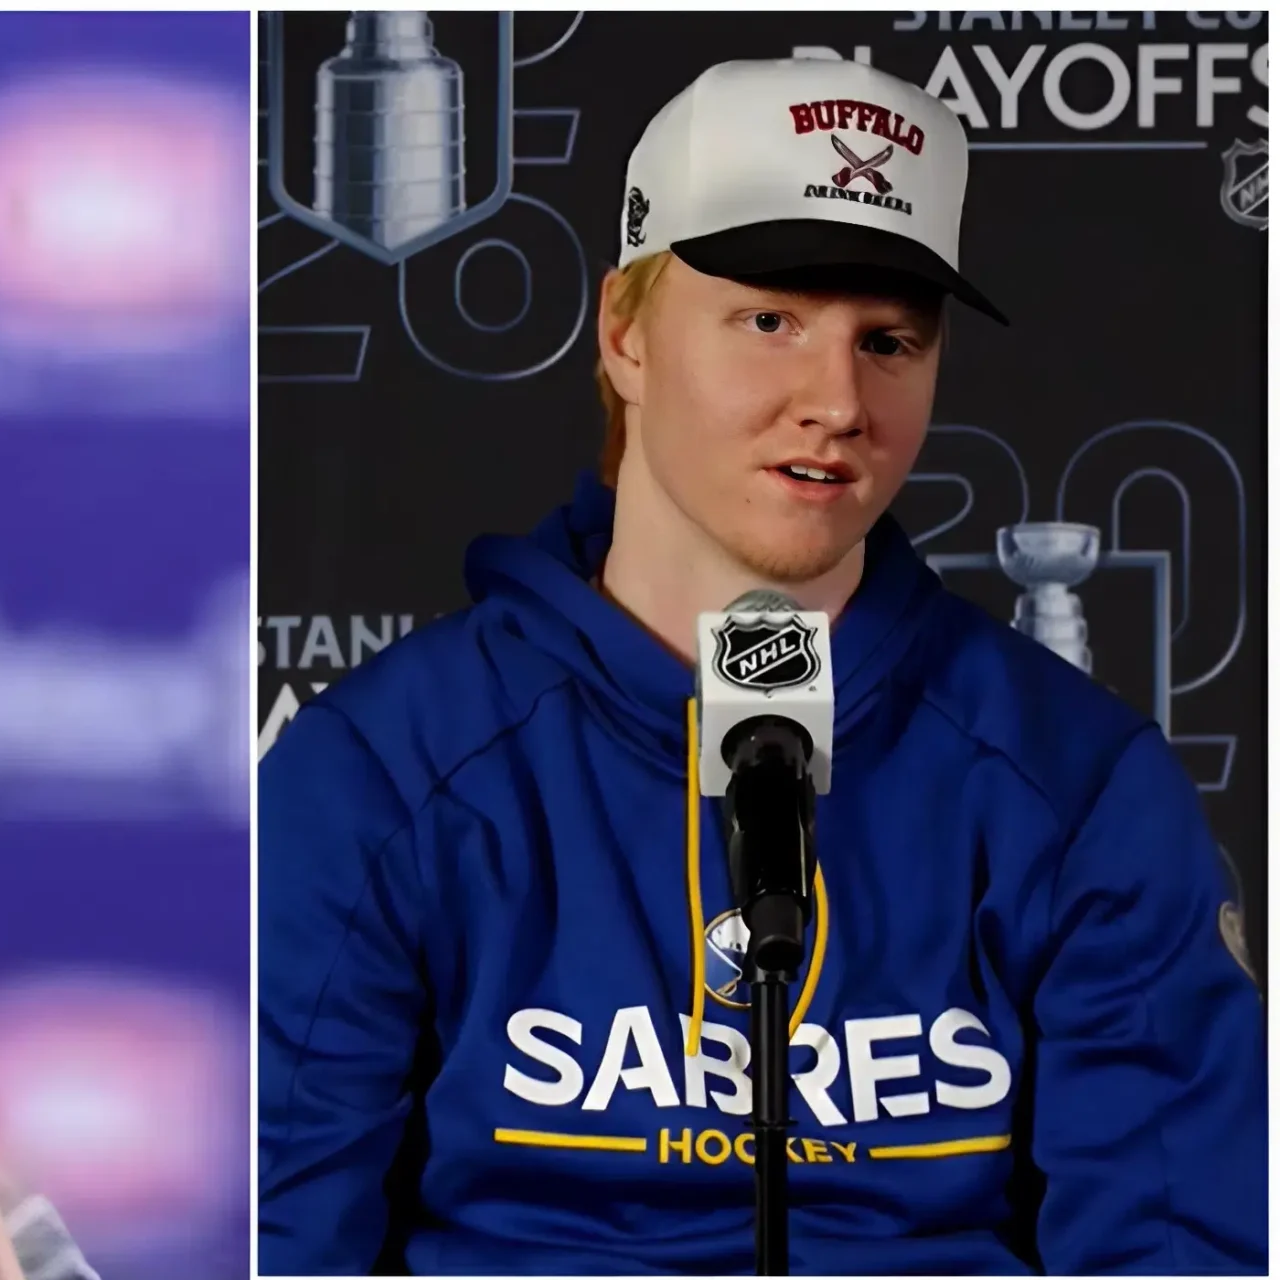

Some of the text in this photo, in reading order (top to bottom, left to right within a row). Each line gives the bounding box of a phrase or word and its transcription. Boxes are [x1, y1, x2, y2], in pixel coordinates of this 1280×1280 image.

[792, 43, 1269, 130] AYOFF
[789, 99, 925, 156] BUFFALO
[258, 614, 414, 669] TAN
[739, 636, 796, 677] NHL
[503, 1004, 1012, 1127] SABRES
